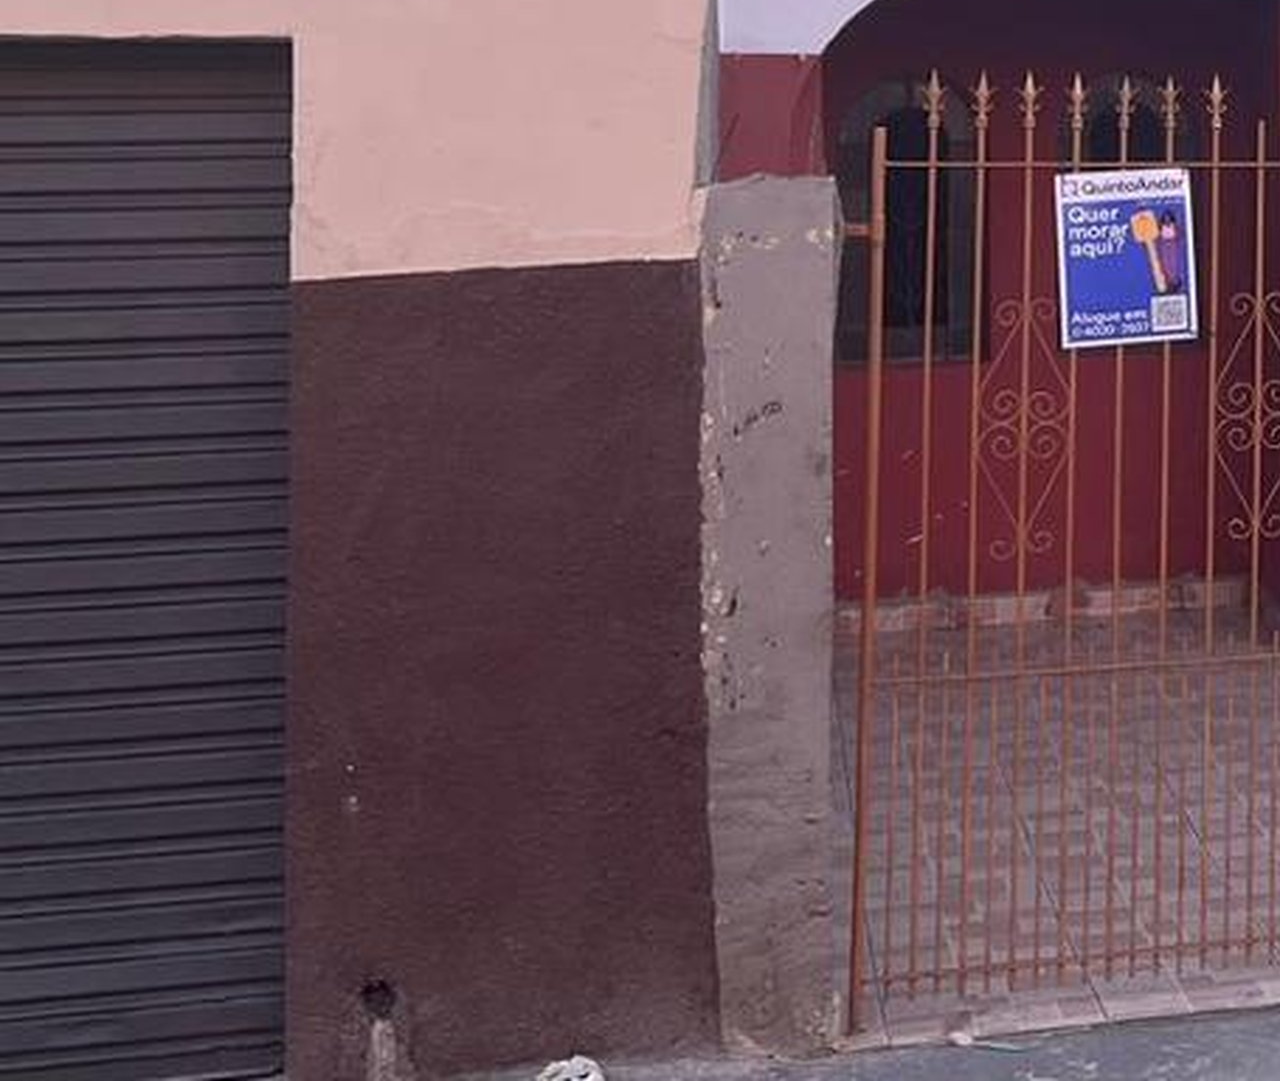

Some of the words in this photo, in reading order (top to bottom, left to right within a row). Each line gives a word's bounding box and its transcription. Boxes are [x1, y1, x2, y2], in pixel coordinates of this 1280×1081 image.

[1082, 176, 1183, 195] QuintoAndar
[1068, 206, 1119, 223] Quer
[1069, 224, 1129, 240] morar
[1070, 237, 1125, 259] aqui?
